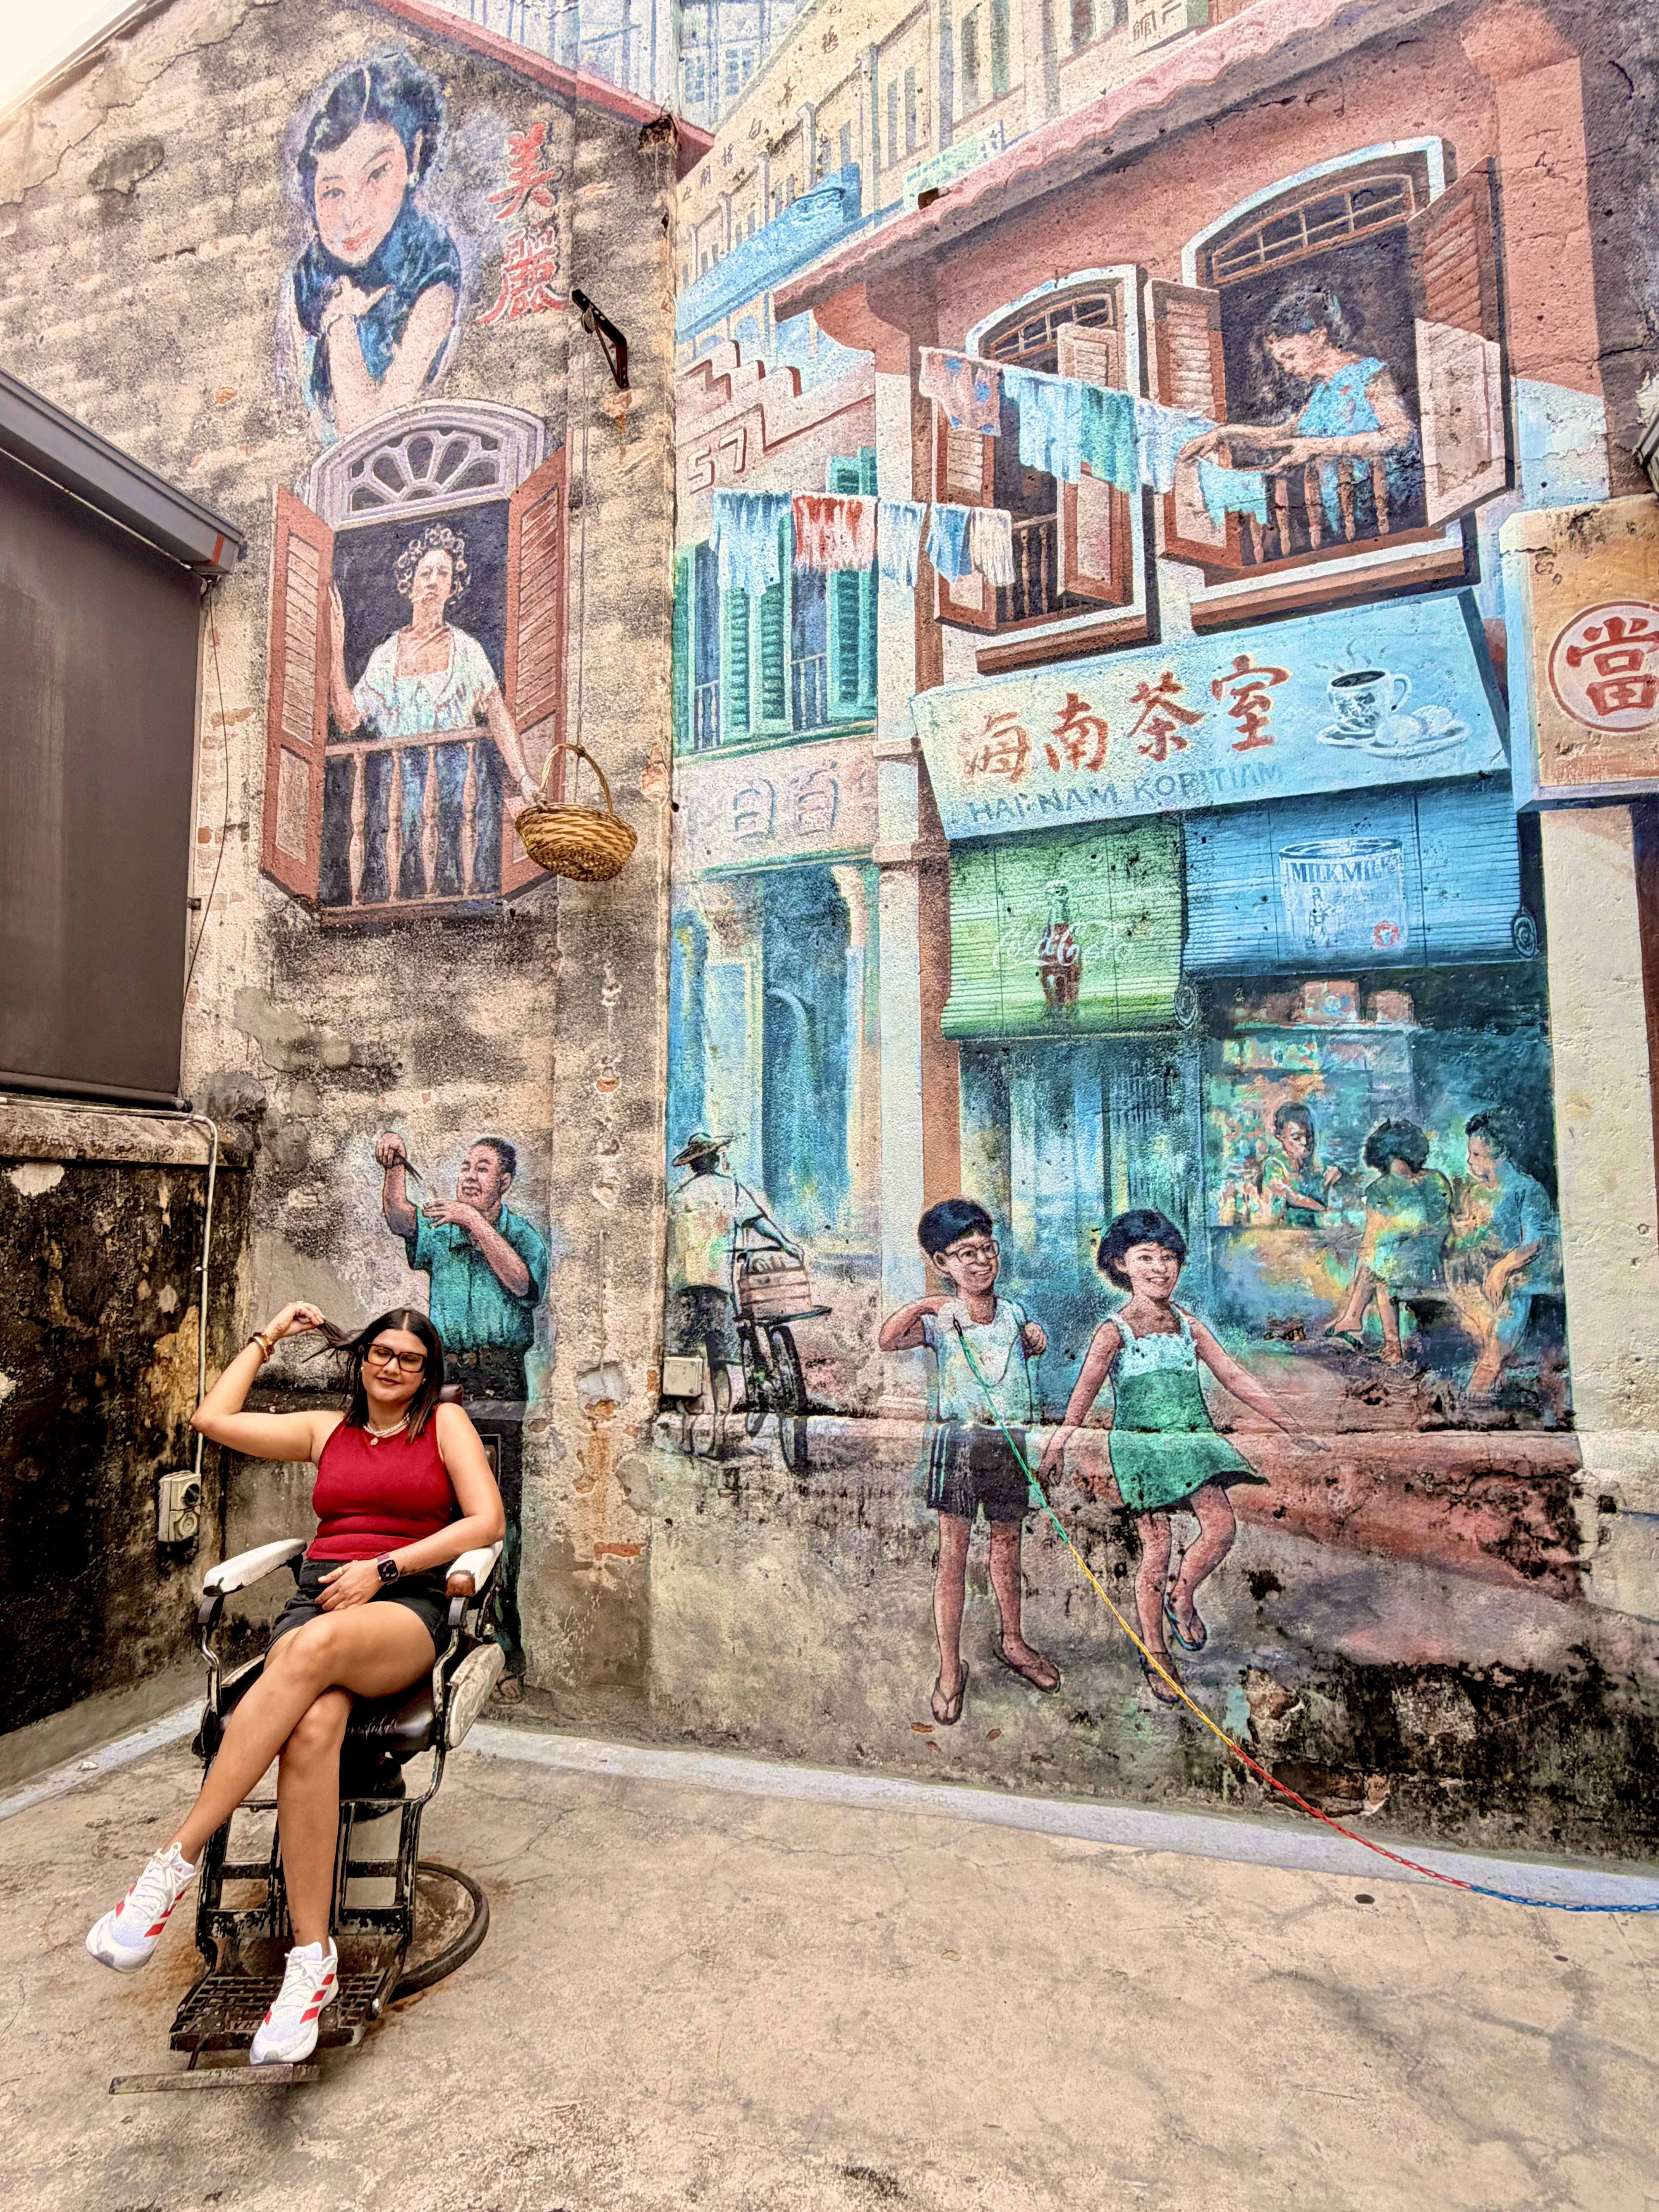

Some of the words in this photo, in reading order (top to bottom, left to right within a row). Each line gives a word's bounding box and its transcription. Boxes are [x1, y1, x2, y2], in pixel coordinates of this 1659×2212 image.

[963, 653, 1293, 783] 海南茶室
[1566, 617, 1659, 716] 當
